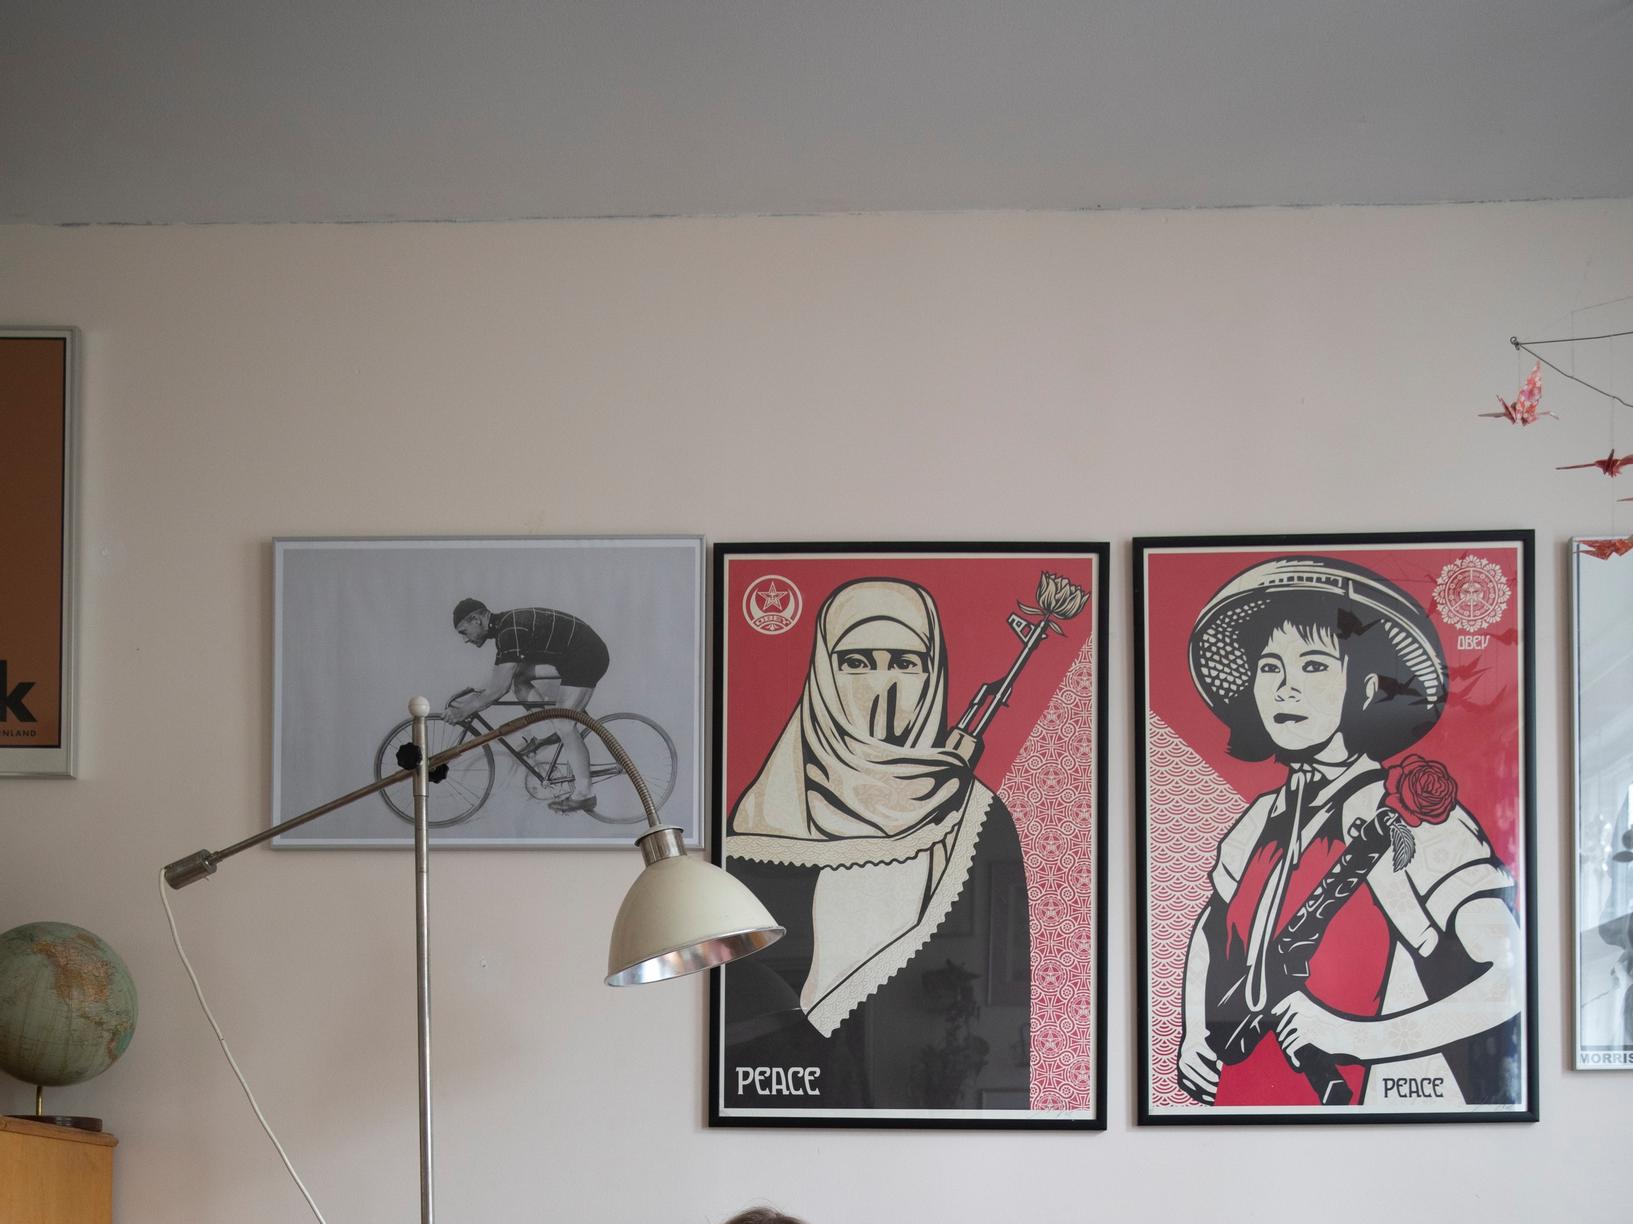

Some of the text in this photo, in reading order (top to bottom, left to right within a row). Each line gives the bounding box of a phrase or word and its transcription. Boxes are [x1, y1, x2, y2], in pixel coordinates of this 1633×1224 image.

[1457, 635, 1490, 650] OBEY
[0, 729, 37, 737] NLAND
[735, 1066, 821, 1095] PEACE
[1382, 1077, 1445, 1098] PEACE
